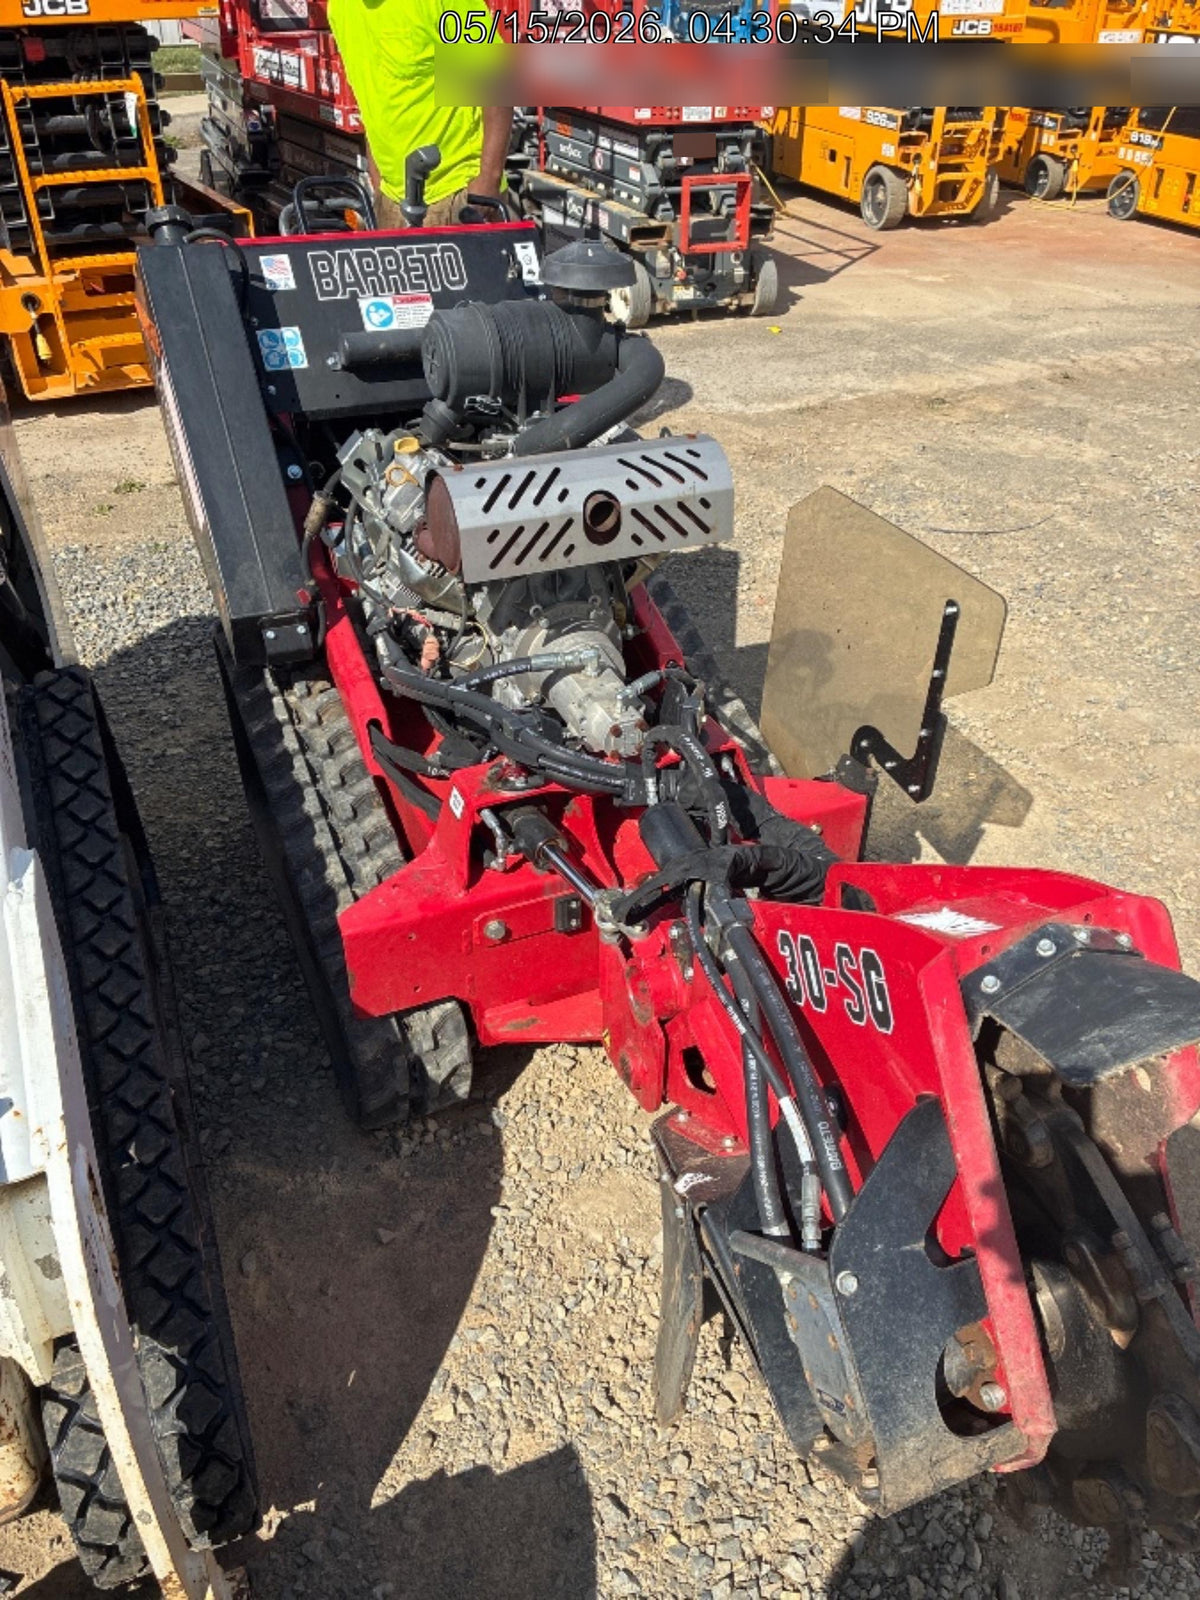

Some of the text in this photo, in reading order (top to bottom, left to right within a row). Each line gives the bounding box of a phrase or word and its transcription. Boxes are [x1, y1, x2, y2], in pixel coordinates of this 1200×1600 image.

[24, 0, 88, 15] JCB
[952, 20, 992, 35] JCB
[307, 244, 467, 301] BARRETO
[777, 930, 894, 1034] 30-SG
